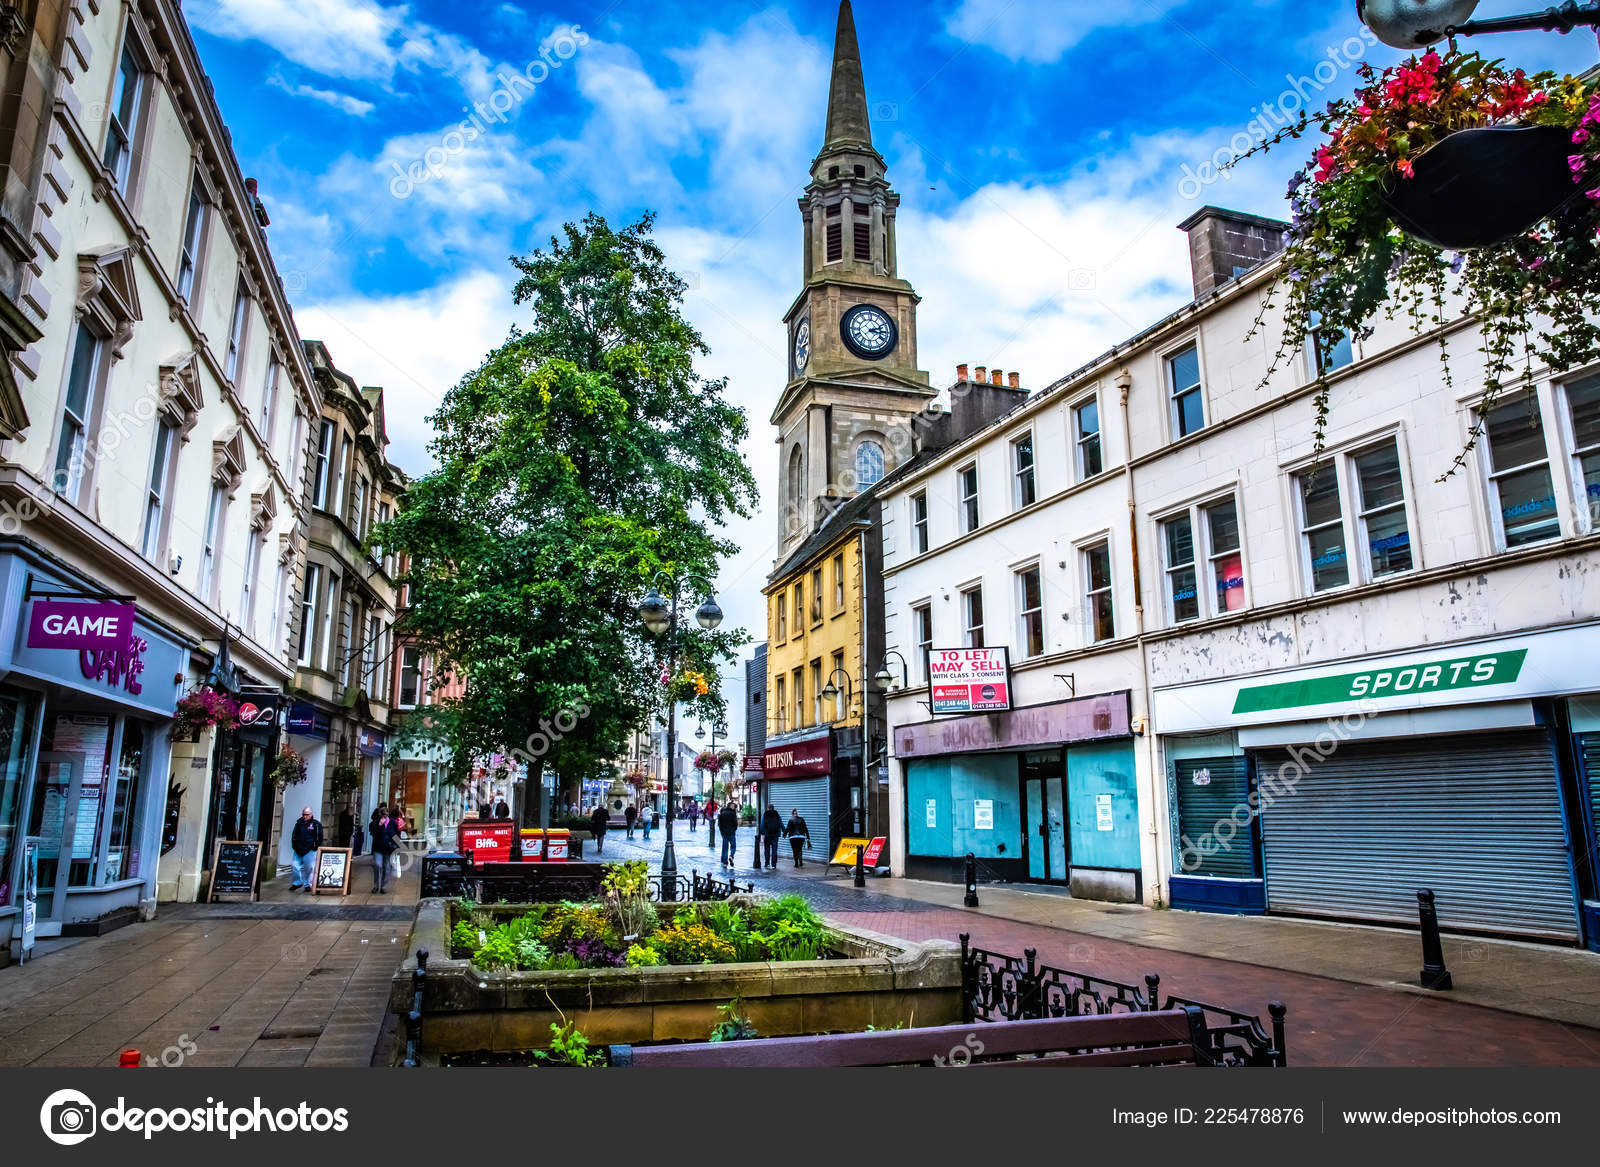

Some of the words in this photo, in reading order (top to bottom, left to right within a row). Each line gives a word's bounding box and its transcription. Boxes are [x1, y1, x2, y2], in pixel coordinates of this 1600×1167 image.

[42, 614, 119, 637] GAME
[940, 651, 959, 661] TO
[965, 650, 994, 661] LET/
[932, 662, 963, 672] MAY
[971, 660, 1004, 671] SELL
[1349, 657, 1498, 697] SPORTS
[766, 751, 794, 768] TIMPSON
[475, 837, 498, 849] Biffa
